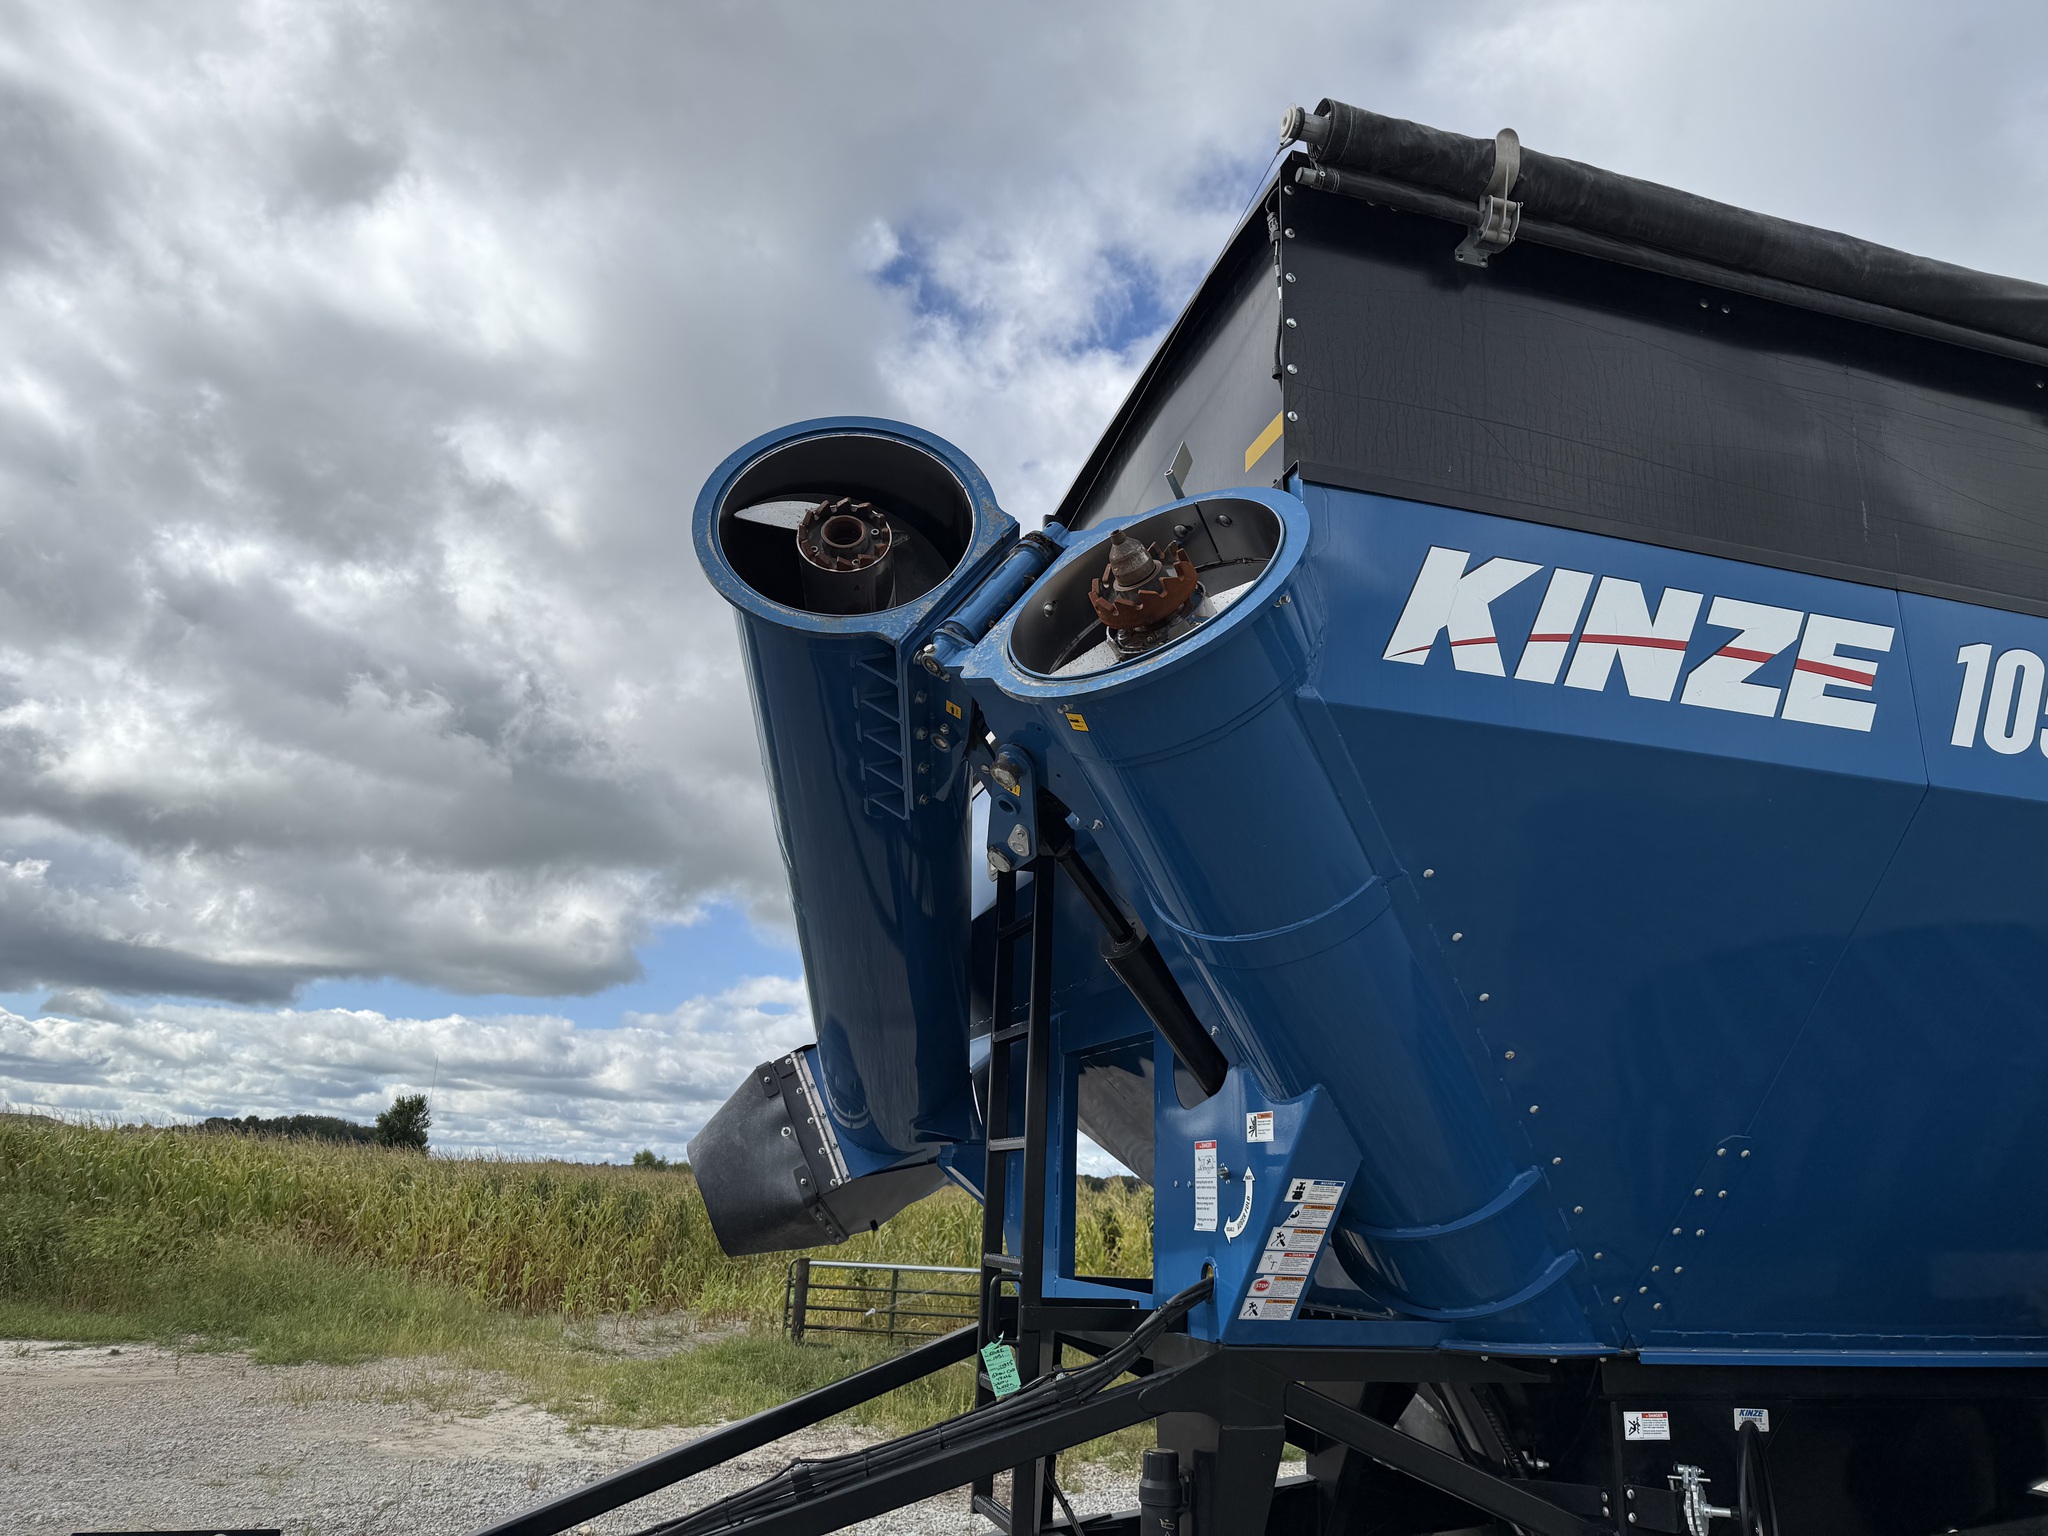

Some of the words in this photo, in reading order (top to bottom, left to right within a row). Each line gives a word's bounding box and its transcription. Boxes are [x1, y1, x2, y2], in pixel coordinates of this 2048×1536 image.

[1382, 545, 1895, 732] KINZE
[1951, 643, 2048, 759] 10
[1739, 1409, 1764, 1417] KINZE
